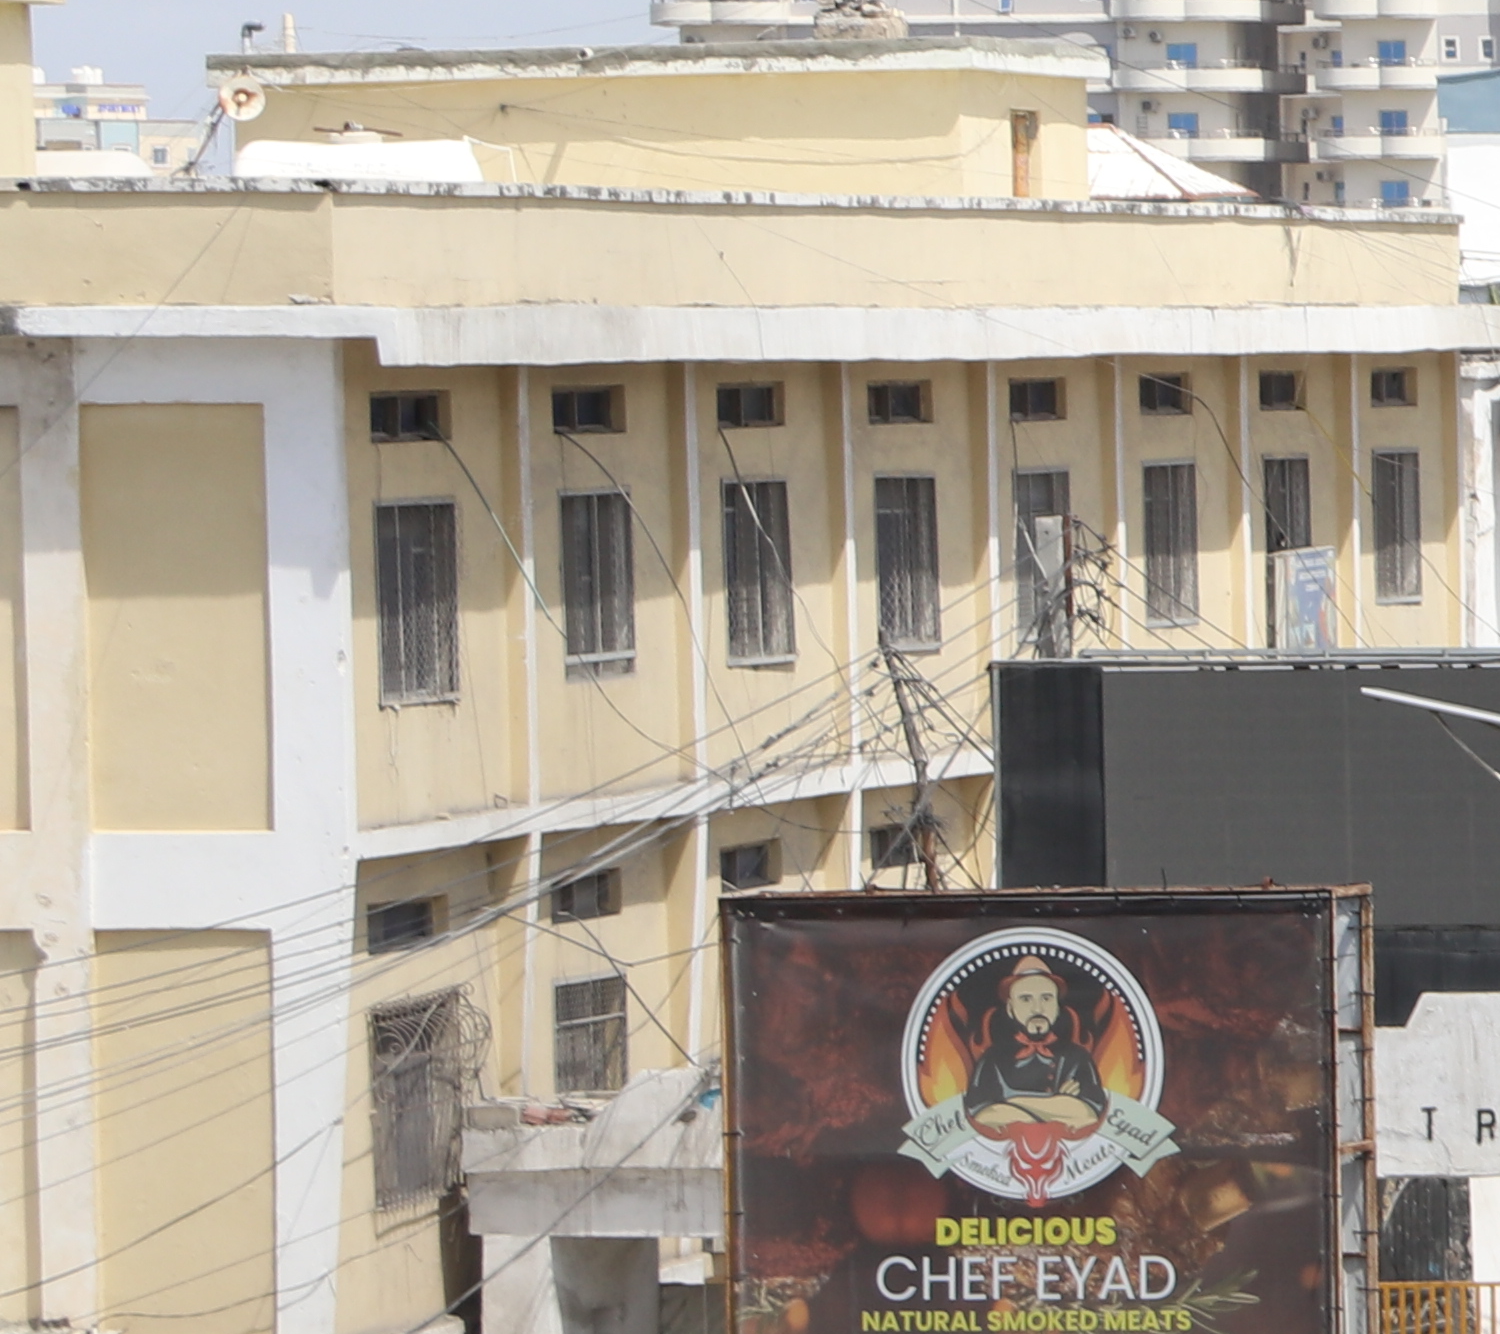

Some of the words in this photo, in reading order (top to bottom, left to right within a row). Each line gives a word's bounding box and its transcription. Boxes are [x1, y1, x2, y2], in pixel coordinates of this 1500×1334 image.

[912, 1109, 967, 1147] Chef
[1106, 1107, 1159, 1147] Eyad
[935, 1216, 1118, 1247] DELICIOUS
[875, 1255, 1018, 1304] CHEF
[1034, 1253, 1178, 1302] EYAD
[861, 1310, 983, 1334] NATURAL
[987, 1309, 1098, 1333] SMOKED
[1103, 1307, 1193, 1332] MEATS
